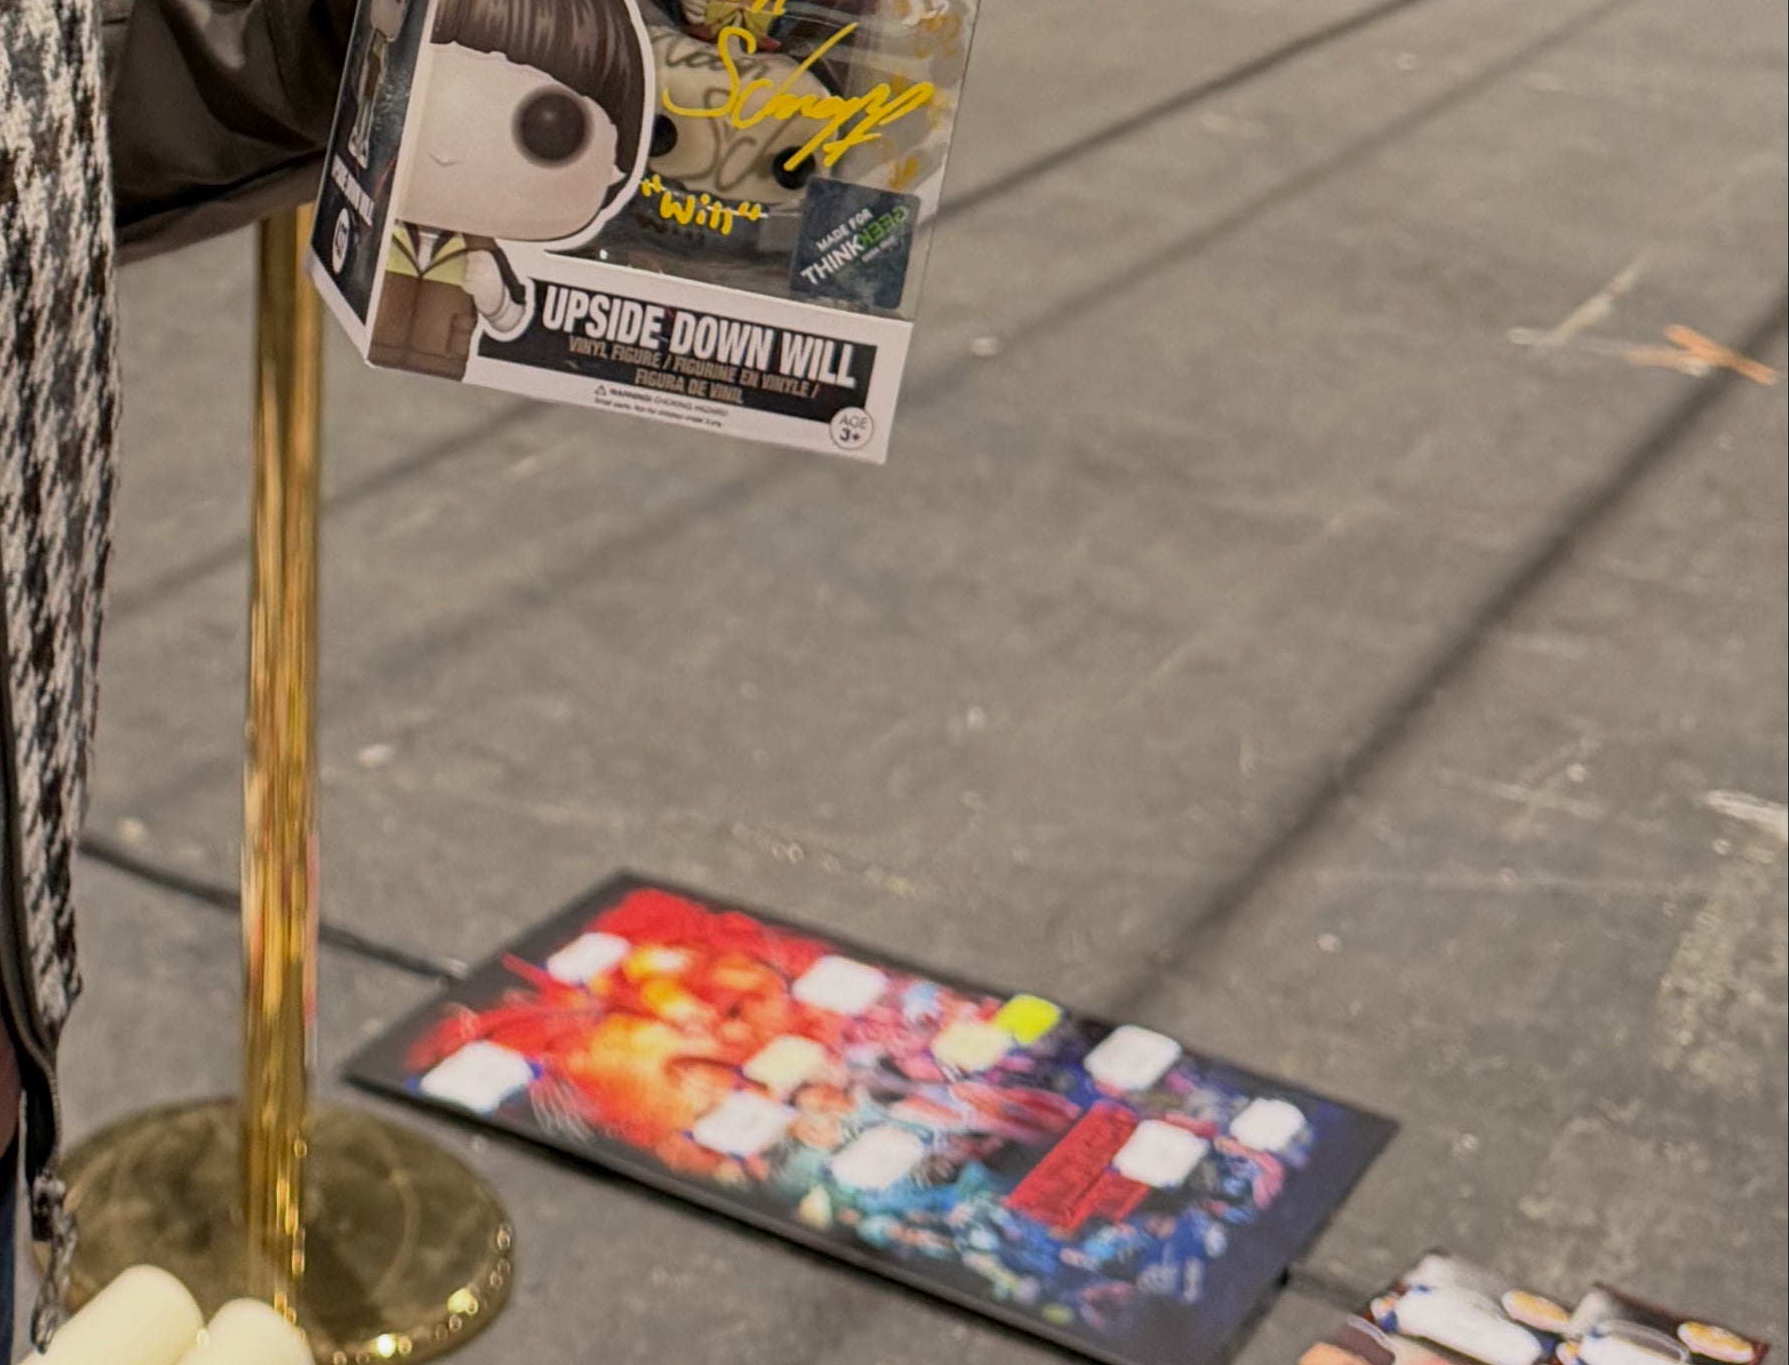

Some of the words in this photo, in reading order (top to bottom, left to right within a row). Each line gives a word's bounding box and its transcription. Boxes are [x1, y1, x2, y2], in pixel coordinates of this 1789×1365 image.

[816, 223, 850, 252] MADE
[848, 208, 874, 230] FOR
[542, 285, 665, 350] UPSIDE
[668, 311, 774, 372] DOWN
[779, 331, 856, 389] WILL
[569, 335, 608, 360] VINYL
[611, 343, 661, 369] FIGURE
[672, 356, 737, 383] FIGURINE
[739, 370, 759, 388] EN
[761, 373, 810, 398] VINYLE
[634, 368, 685, 393] FIGURA
[687, 378, 706, 397] DE
[839, 414, 868, 430] AGE
[839, 428, 860, 442] 3+
